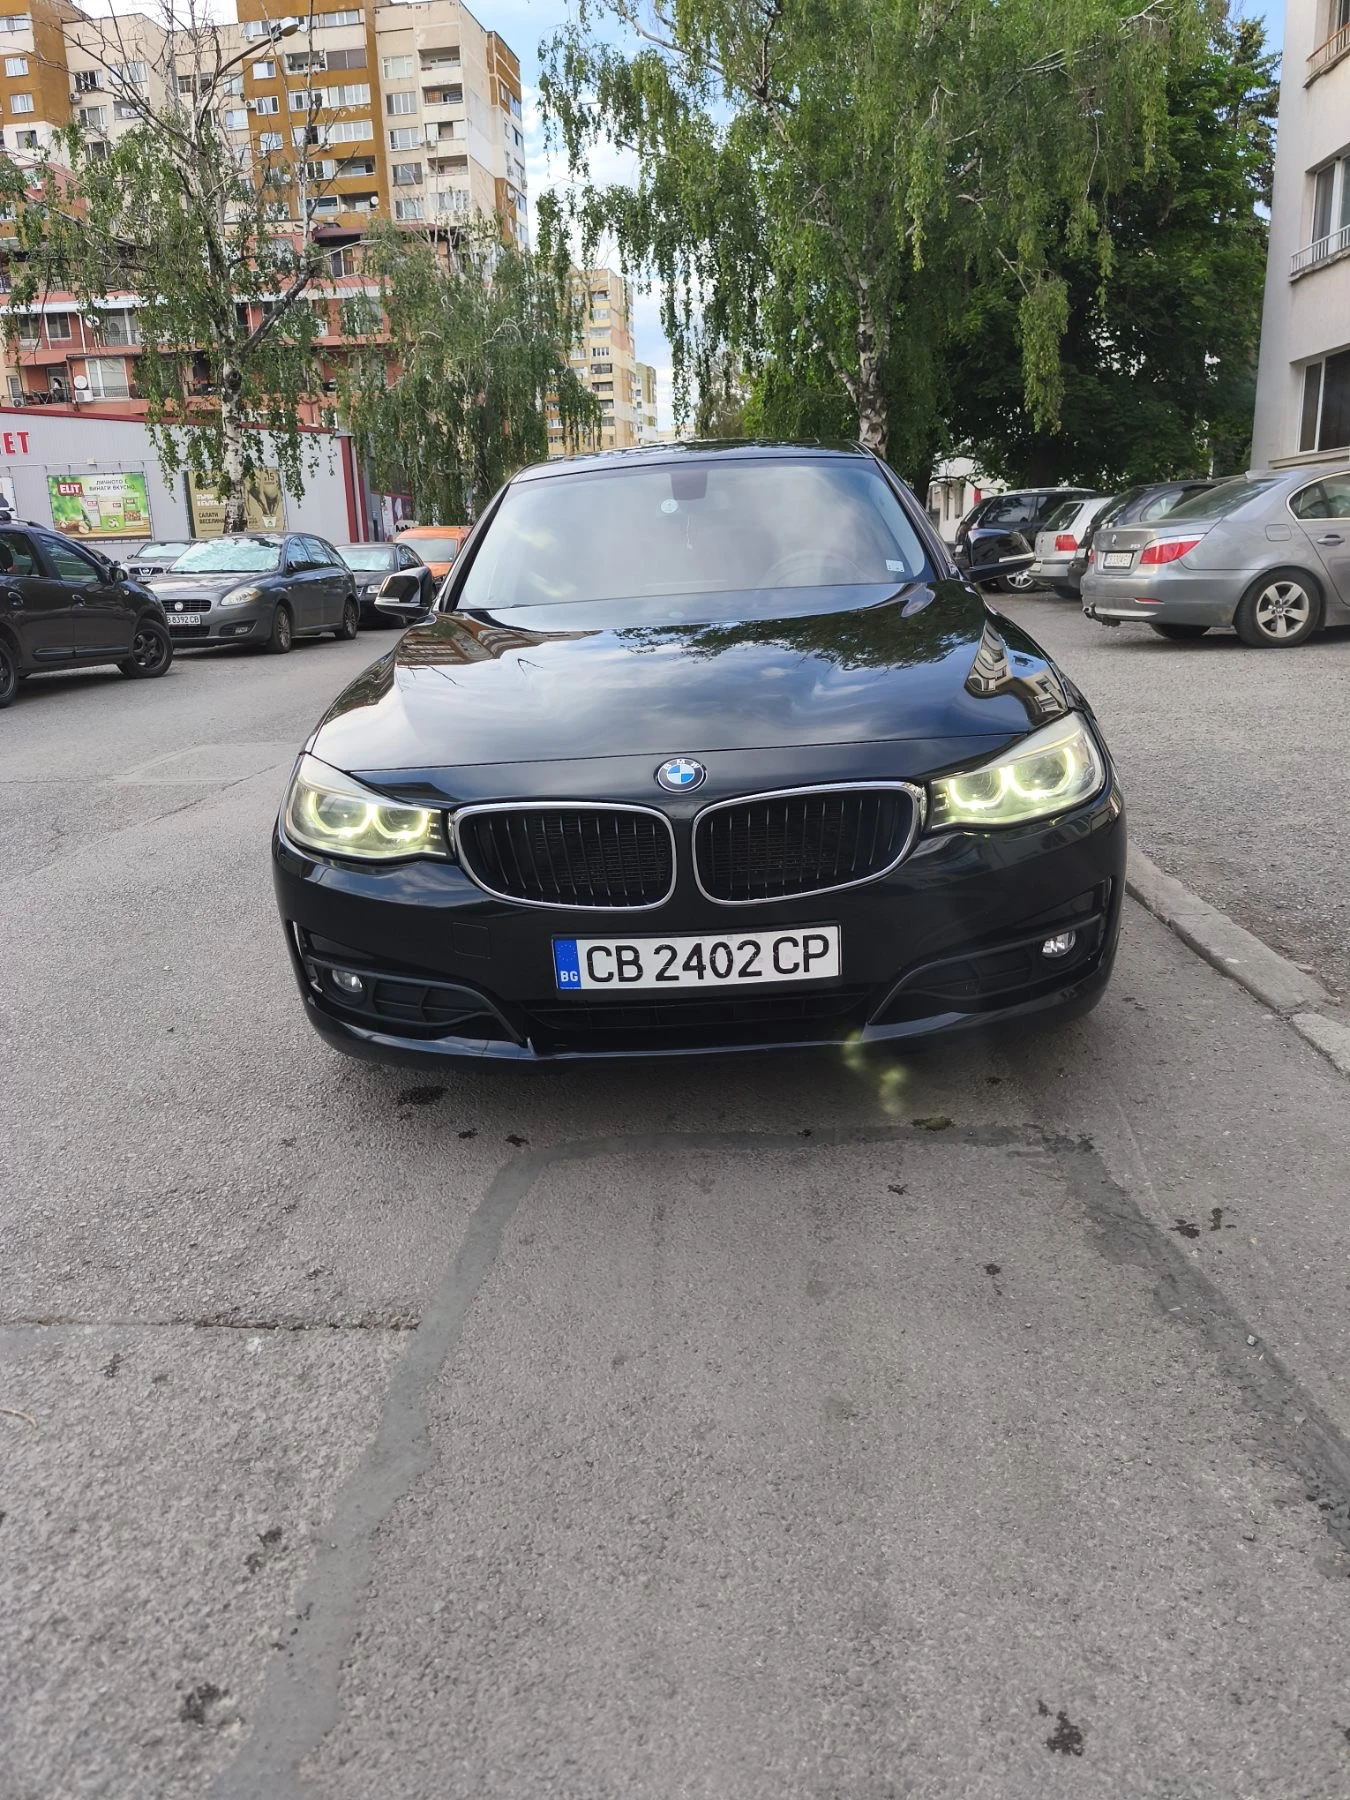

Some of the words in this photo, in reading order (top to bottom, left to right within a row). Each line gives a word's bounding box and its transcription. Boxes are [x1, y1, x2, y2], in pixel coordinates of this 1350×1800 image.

[0, 431, 29, 454] ET
[662, 759, 701, 770] BMW
[586, 945, 643, 983] CB
[653, 939, 763, 982] 2402
[772, 933, 830, 975] CP
[560, 970, 579, 982] BG
